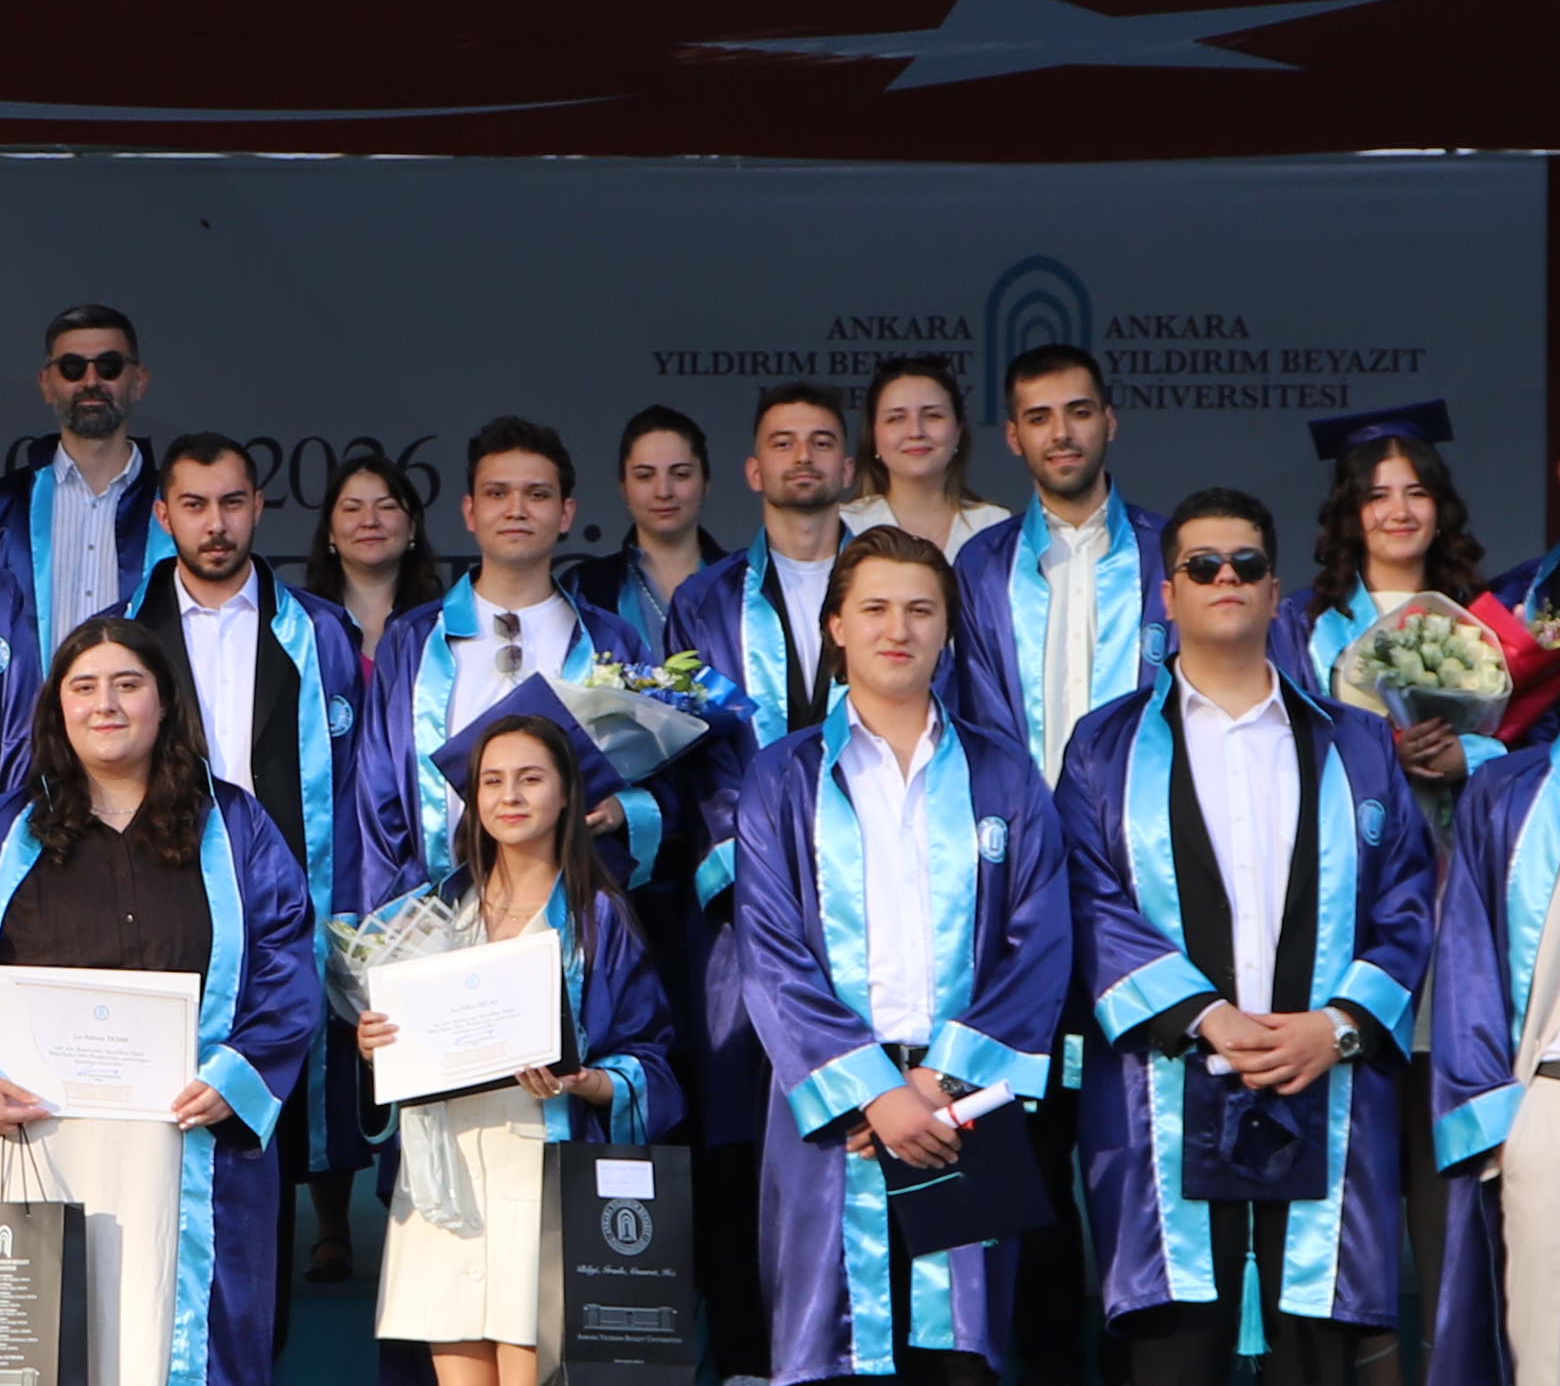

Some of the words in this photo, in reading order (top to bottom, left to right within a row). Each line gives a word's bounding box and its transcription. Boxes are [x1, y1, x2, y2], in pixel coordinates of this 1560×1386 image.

[827, 315, 974, 341] ANKARA
[1103, 313, 1251, 339] ANKARA
[652, 350, 816, 376] YILDIRIM
[1103, 348, 1270, 375] YILDIRIM
[1280, 347, 1427, 374] BEYAZIT
[1106, 375, 1351, 410] ÜNİVERSİTESİ
